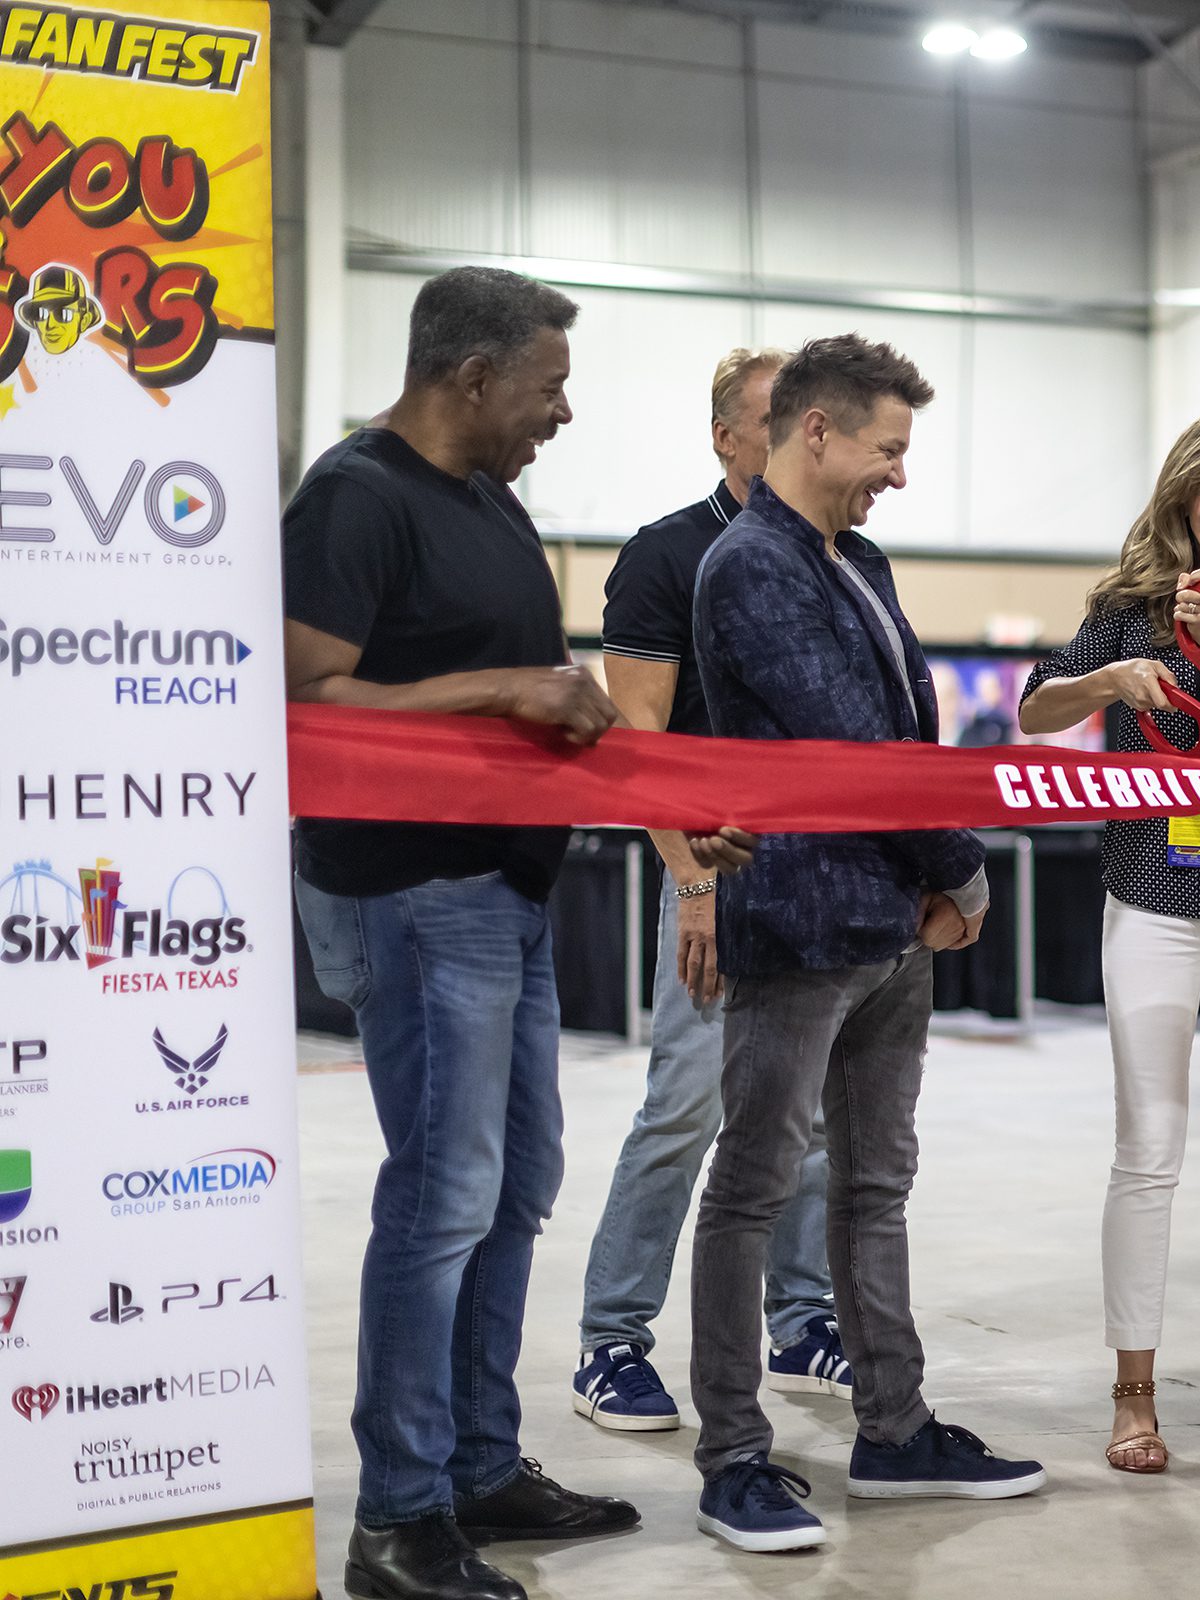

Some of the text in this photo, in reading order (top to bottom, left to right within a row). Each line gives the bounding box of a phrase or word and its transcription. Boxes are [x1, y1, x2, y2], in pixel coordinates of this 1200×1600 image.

[0, 8, 251, 86] FAN FEST
[0, 114, 204, 234] YOU
[0, 453, 226, 548] EVO
[0, 618, 235, 677] pectrum
[115, 677, 236, 704] REACH
[18, 772, 256, 820] HENRY
[0, 908, 247, 965] Six Flags
[102, 968, 239, 994] FIESTA TEXAS
[135, 1095, 250, 1113] U.S. AIR FORCE
[110, 1193, 261, 1217] GROUP San Antonio
[161, 1274, 279, 1313] PS4
[73, 1441, 221, 1485] trumpet
[81, 1438, 132, 1455] NOISY
[77, 1482, 222, 1511] DIGITAL & PUBLIC RELATIONS
